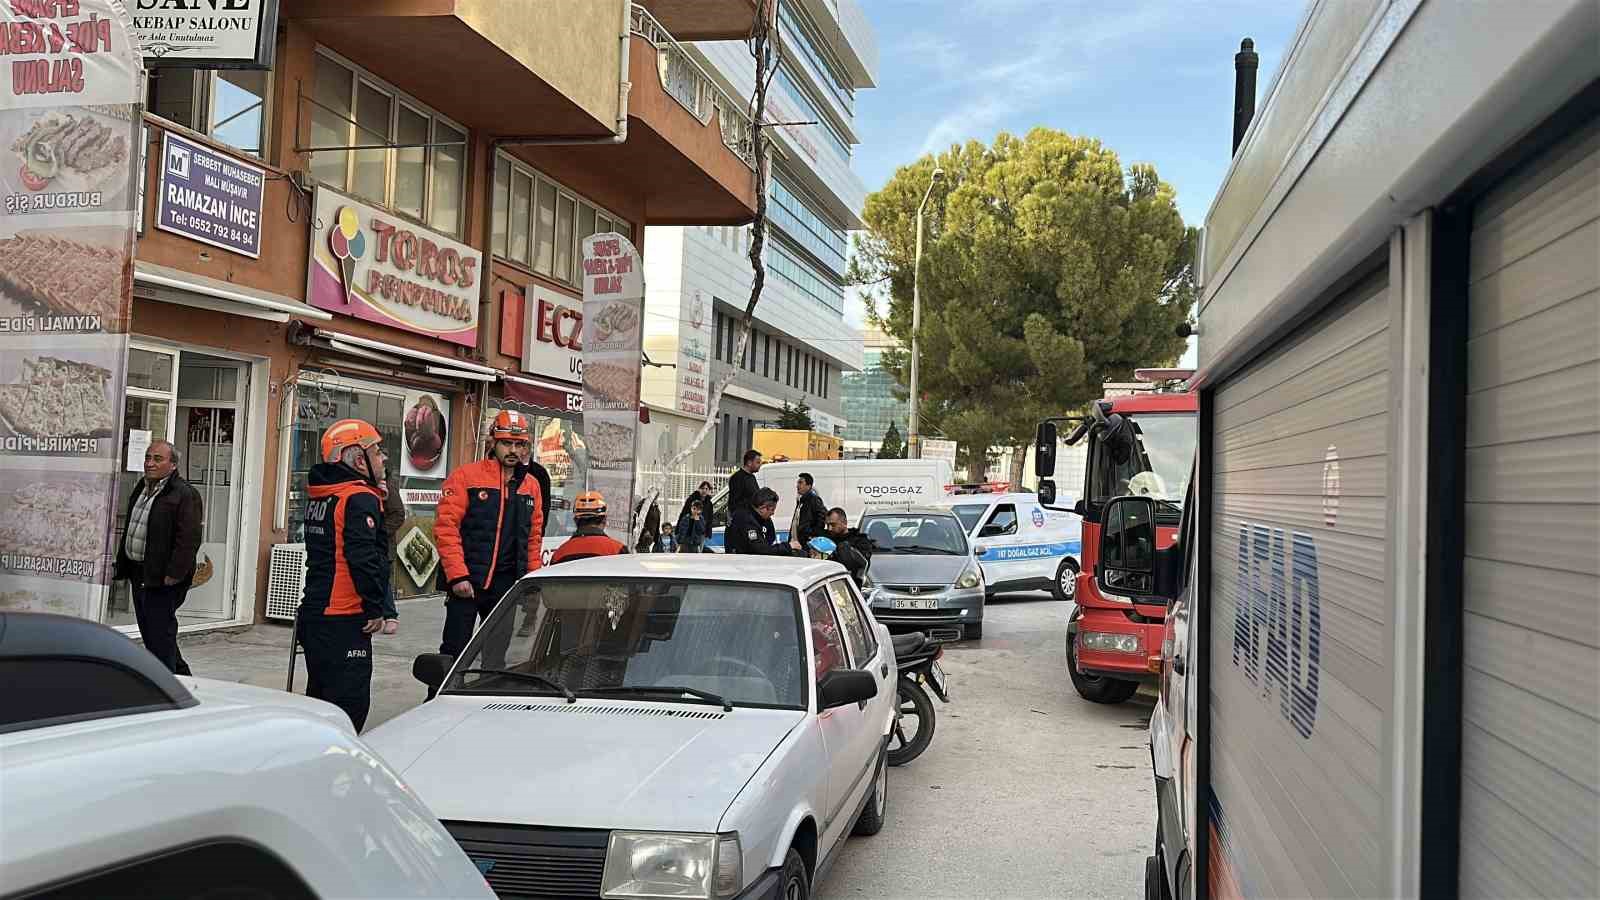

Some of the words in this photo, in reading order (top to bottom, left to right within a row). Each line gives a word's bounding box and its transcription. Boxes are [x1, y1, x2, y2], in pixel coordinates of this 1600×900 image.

[133, 16, 185, 29] KEBAP
[189, 17, 252, 30] SALONU
[193, 152, 222, 173] SERBEST
[167, 182, 228, 220] RAMAZAN
[229, 200, 257, 229] İNCE
[170, 209, 188, 226] Tel:
[189, 215, 212, 235] 0552
[213, 223, 229, 239] 792
[230, 228, 242, 243] 84
[242, 232, 254, 246] 94
[371, 218, 476, 289] TOROS
[857, 486, 922, 497] TOROSGAZ
[1232, 520, 1321, 740] AFAD
[346, 649, 367, 658] AFAD
